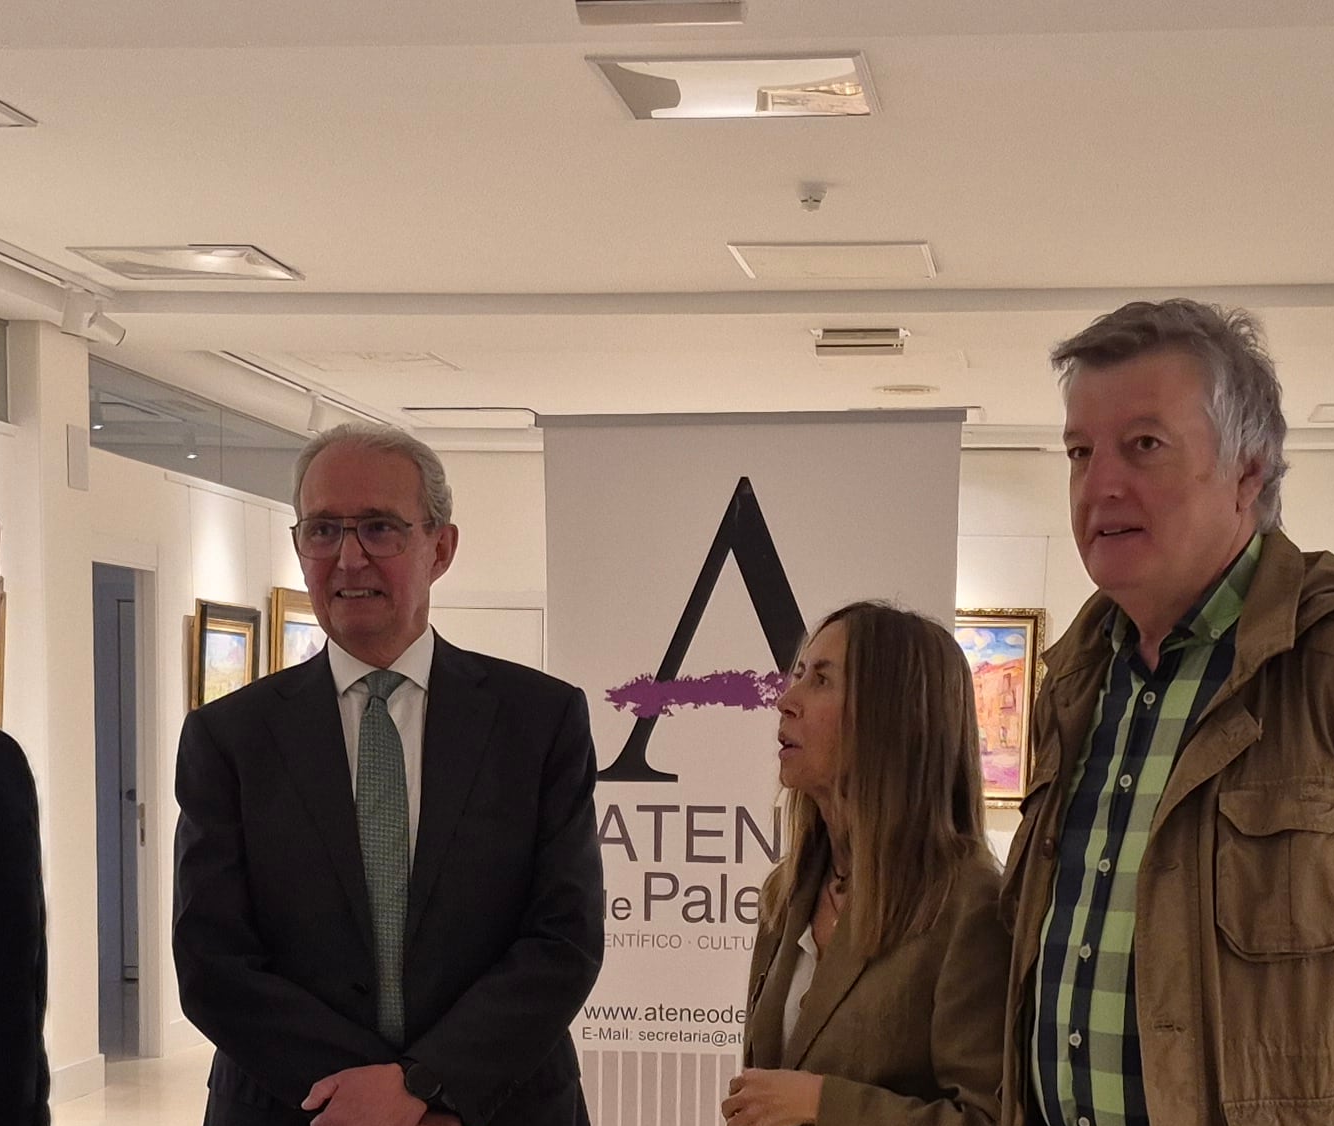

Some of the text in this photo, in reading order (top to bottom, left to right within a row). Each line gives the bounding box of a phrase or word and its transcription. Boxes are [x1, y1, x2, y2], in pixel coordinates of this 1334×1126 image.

[597, 804, 782, 864] ATEN
[643, 871, 762, 925] Pale
[697, 935, 755, 951] CULTU
[583, 1003, 747, 1024] www.ateneode
[582, 1026, 745, 1047] E-Mail: secretaria@at
